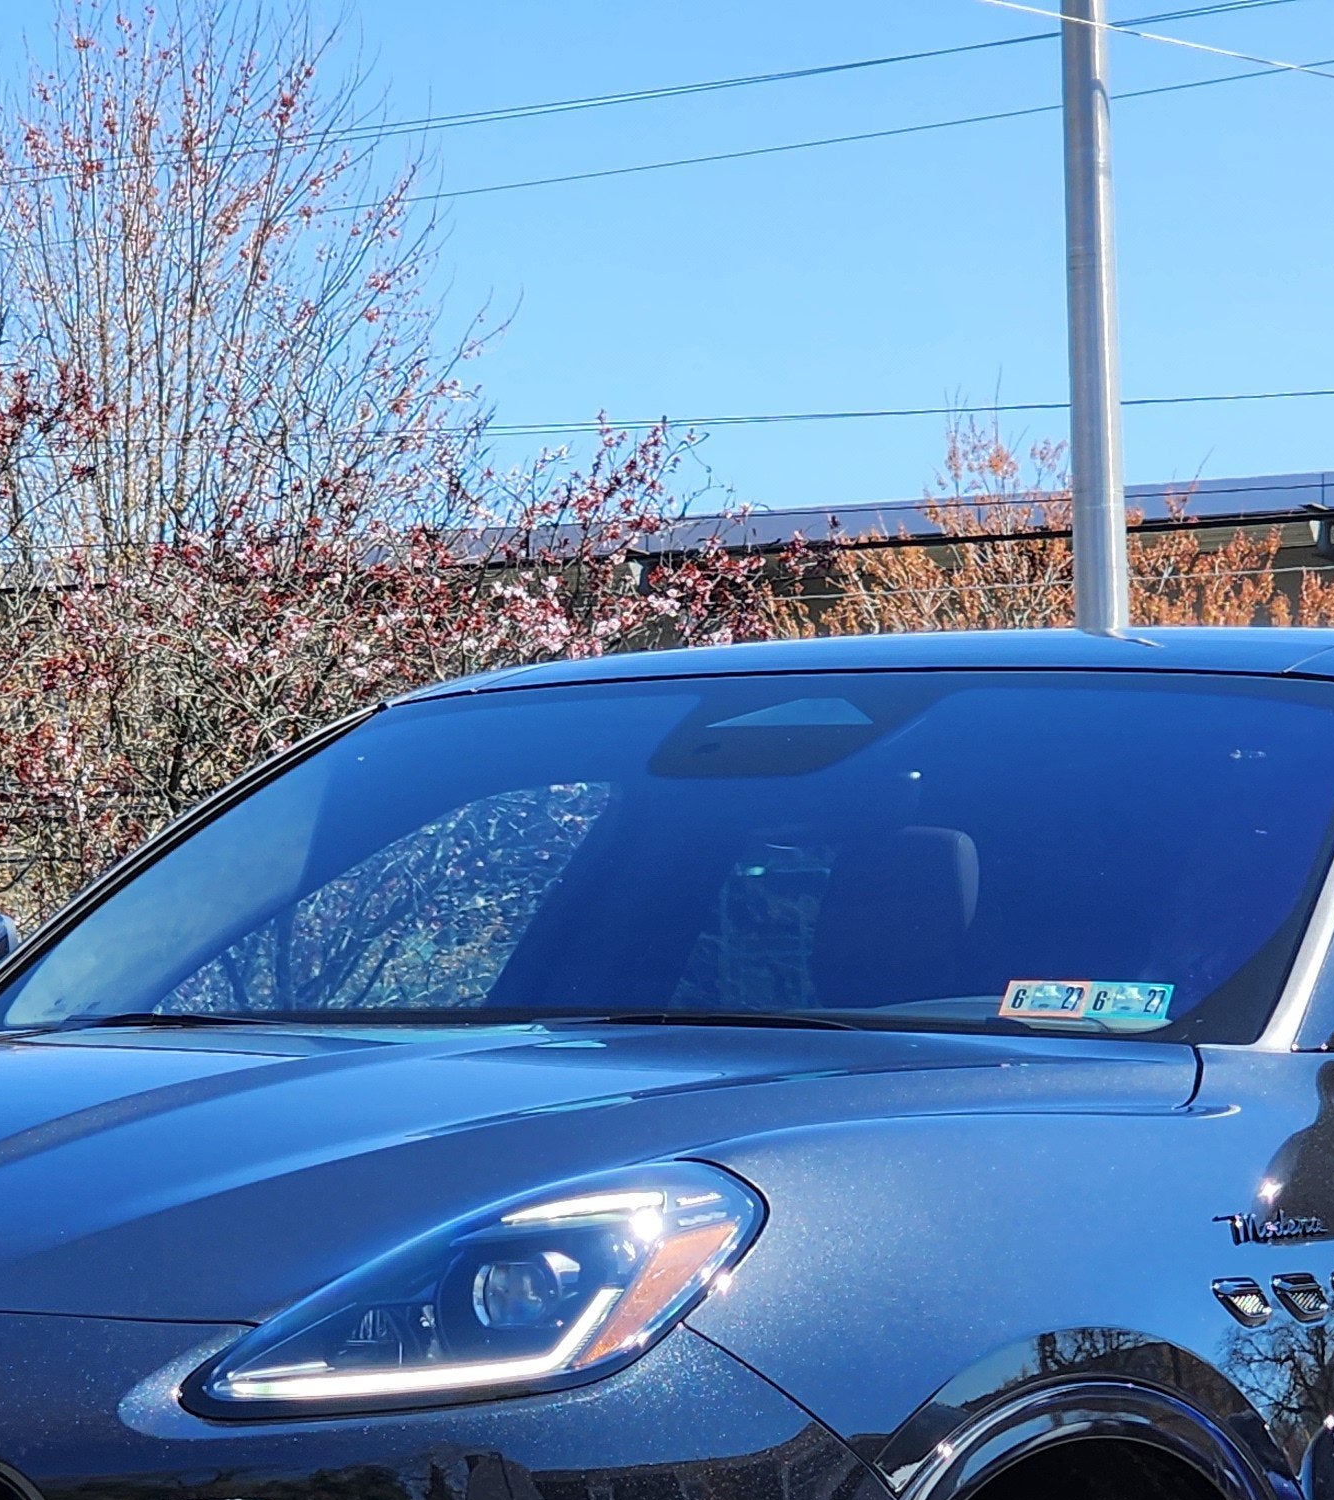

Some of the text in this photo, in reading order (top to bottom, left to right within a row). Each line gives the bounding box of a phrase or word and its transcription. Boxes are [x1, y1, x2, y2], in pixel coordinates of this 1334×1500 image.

[1011, 986, 1085, 1012] 6 27
[1092, 988, 1167, 1014] 6 27
